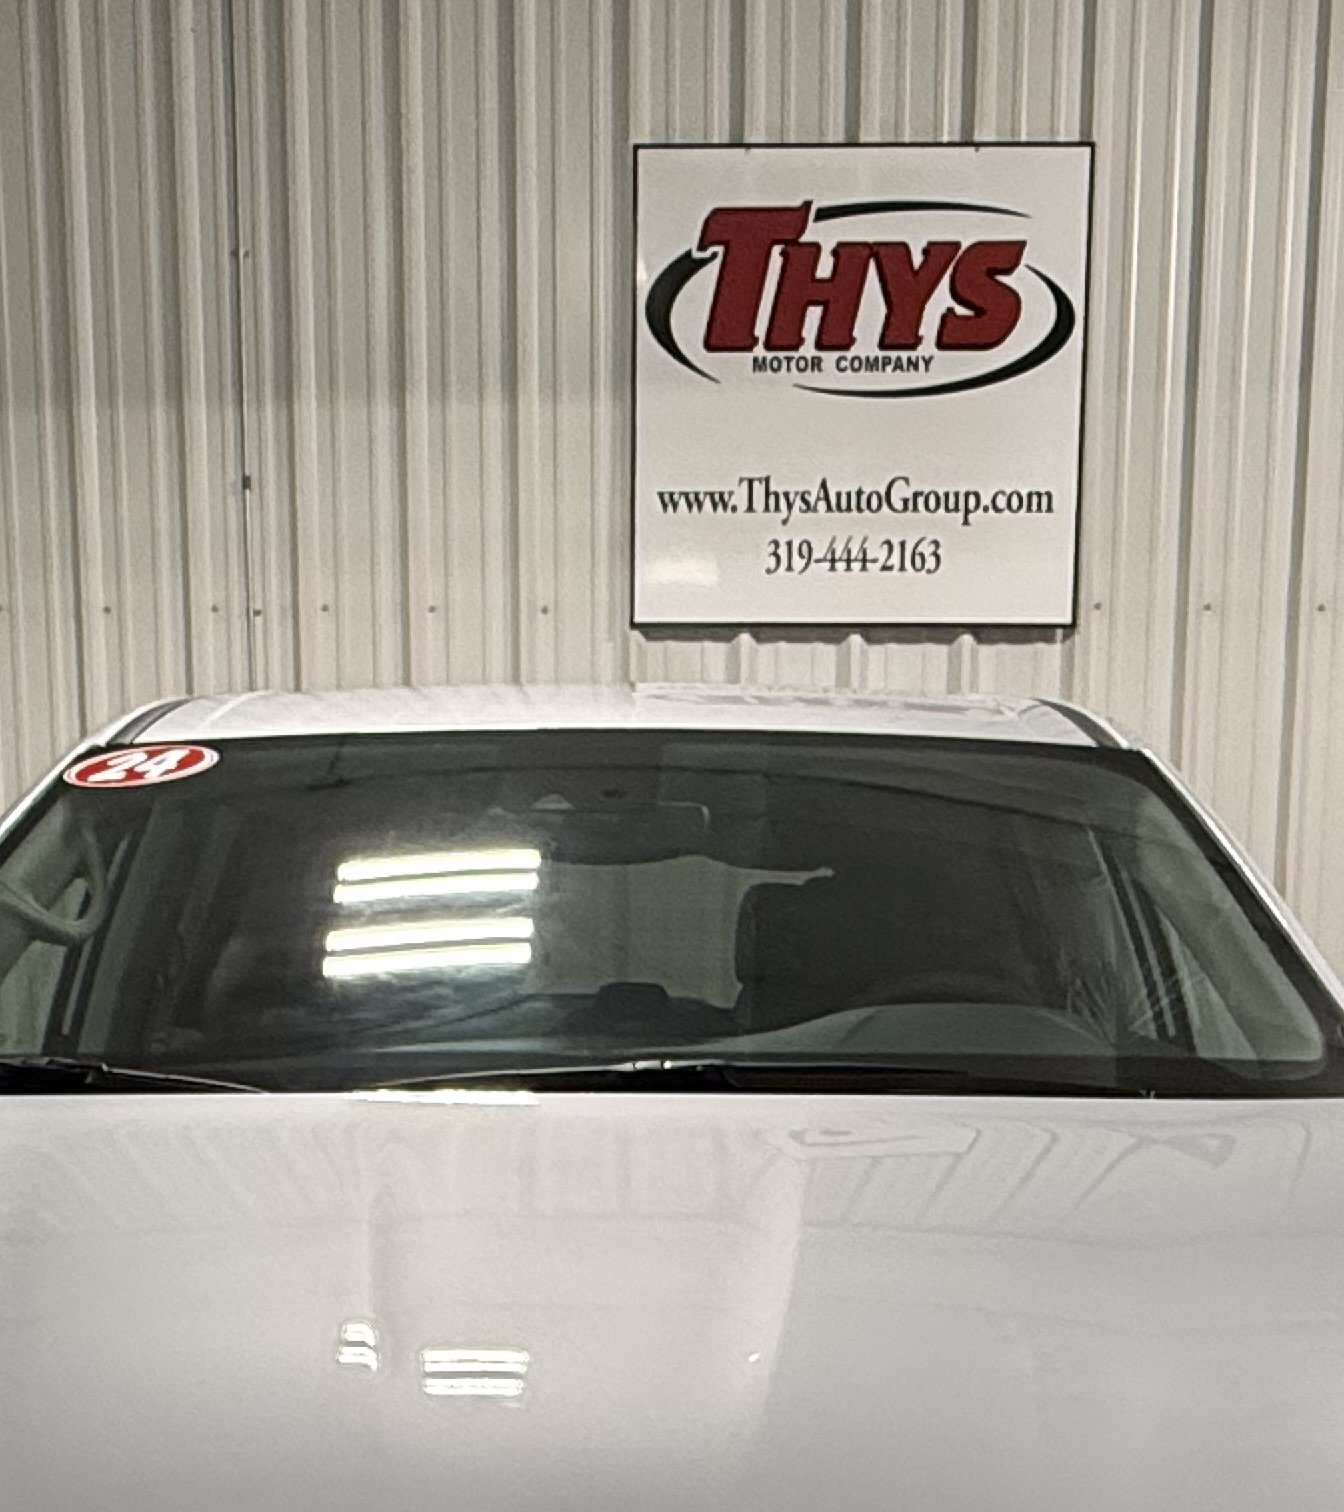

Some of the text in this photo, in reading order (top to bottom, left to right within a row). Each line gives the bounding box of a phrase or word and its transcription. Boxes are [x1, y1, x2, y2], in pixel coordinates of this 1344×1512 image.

[697, 200, 1027, 352] THYS
[753, 356, 934, 374] MOTOR COMPANY
[657, 475, 1054, 526] www.ThysAutoGroup.com
[765, 535, 941, 574] 319-444-2163
[87, 748, 191, 783] 24
